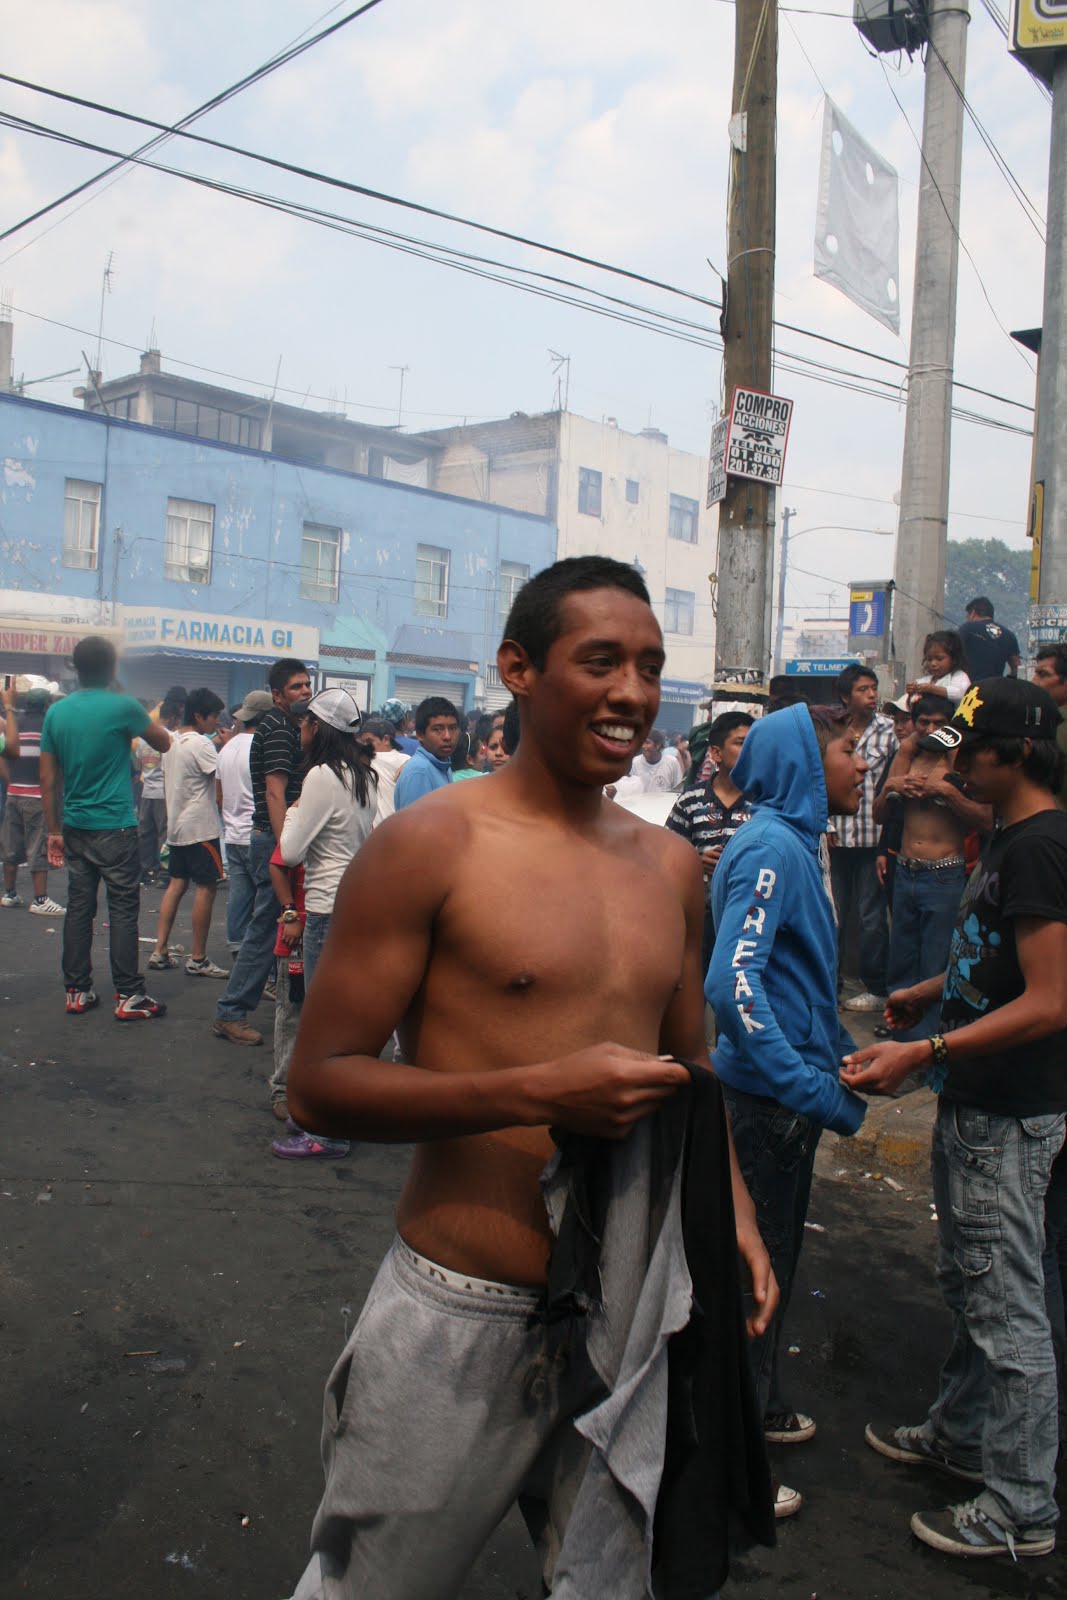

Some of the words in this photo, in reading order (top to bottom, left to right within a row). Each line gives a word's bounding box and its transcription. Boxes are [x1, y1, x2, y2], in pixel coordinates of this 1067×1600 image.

[736, 391, 790, 422] COMPRO
[734, 411, 785, 436] ACCIONES
[730, 446, 781, 467] 01.800
[731, 438, 782, 456] TELMEX
[729, 458, 779, 480] 201.37.38
[0, 631, 48, 651] SUPER
[161, 617, 265, 648] FARMACIA
[271, 629, 294, 649] GI
[812, 663, 849, 672] TELMEX
[731, 868, 777, 1034] BREAK
